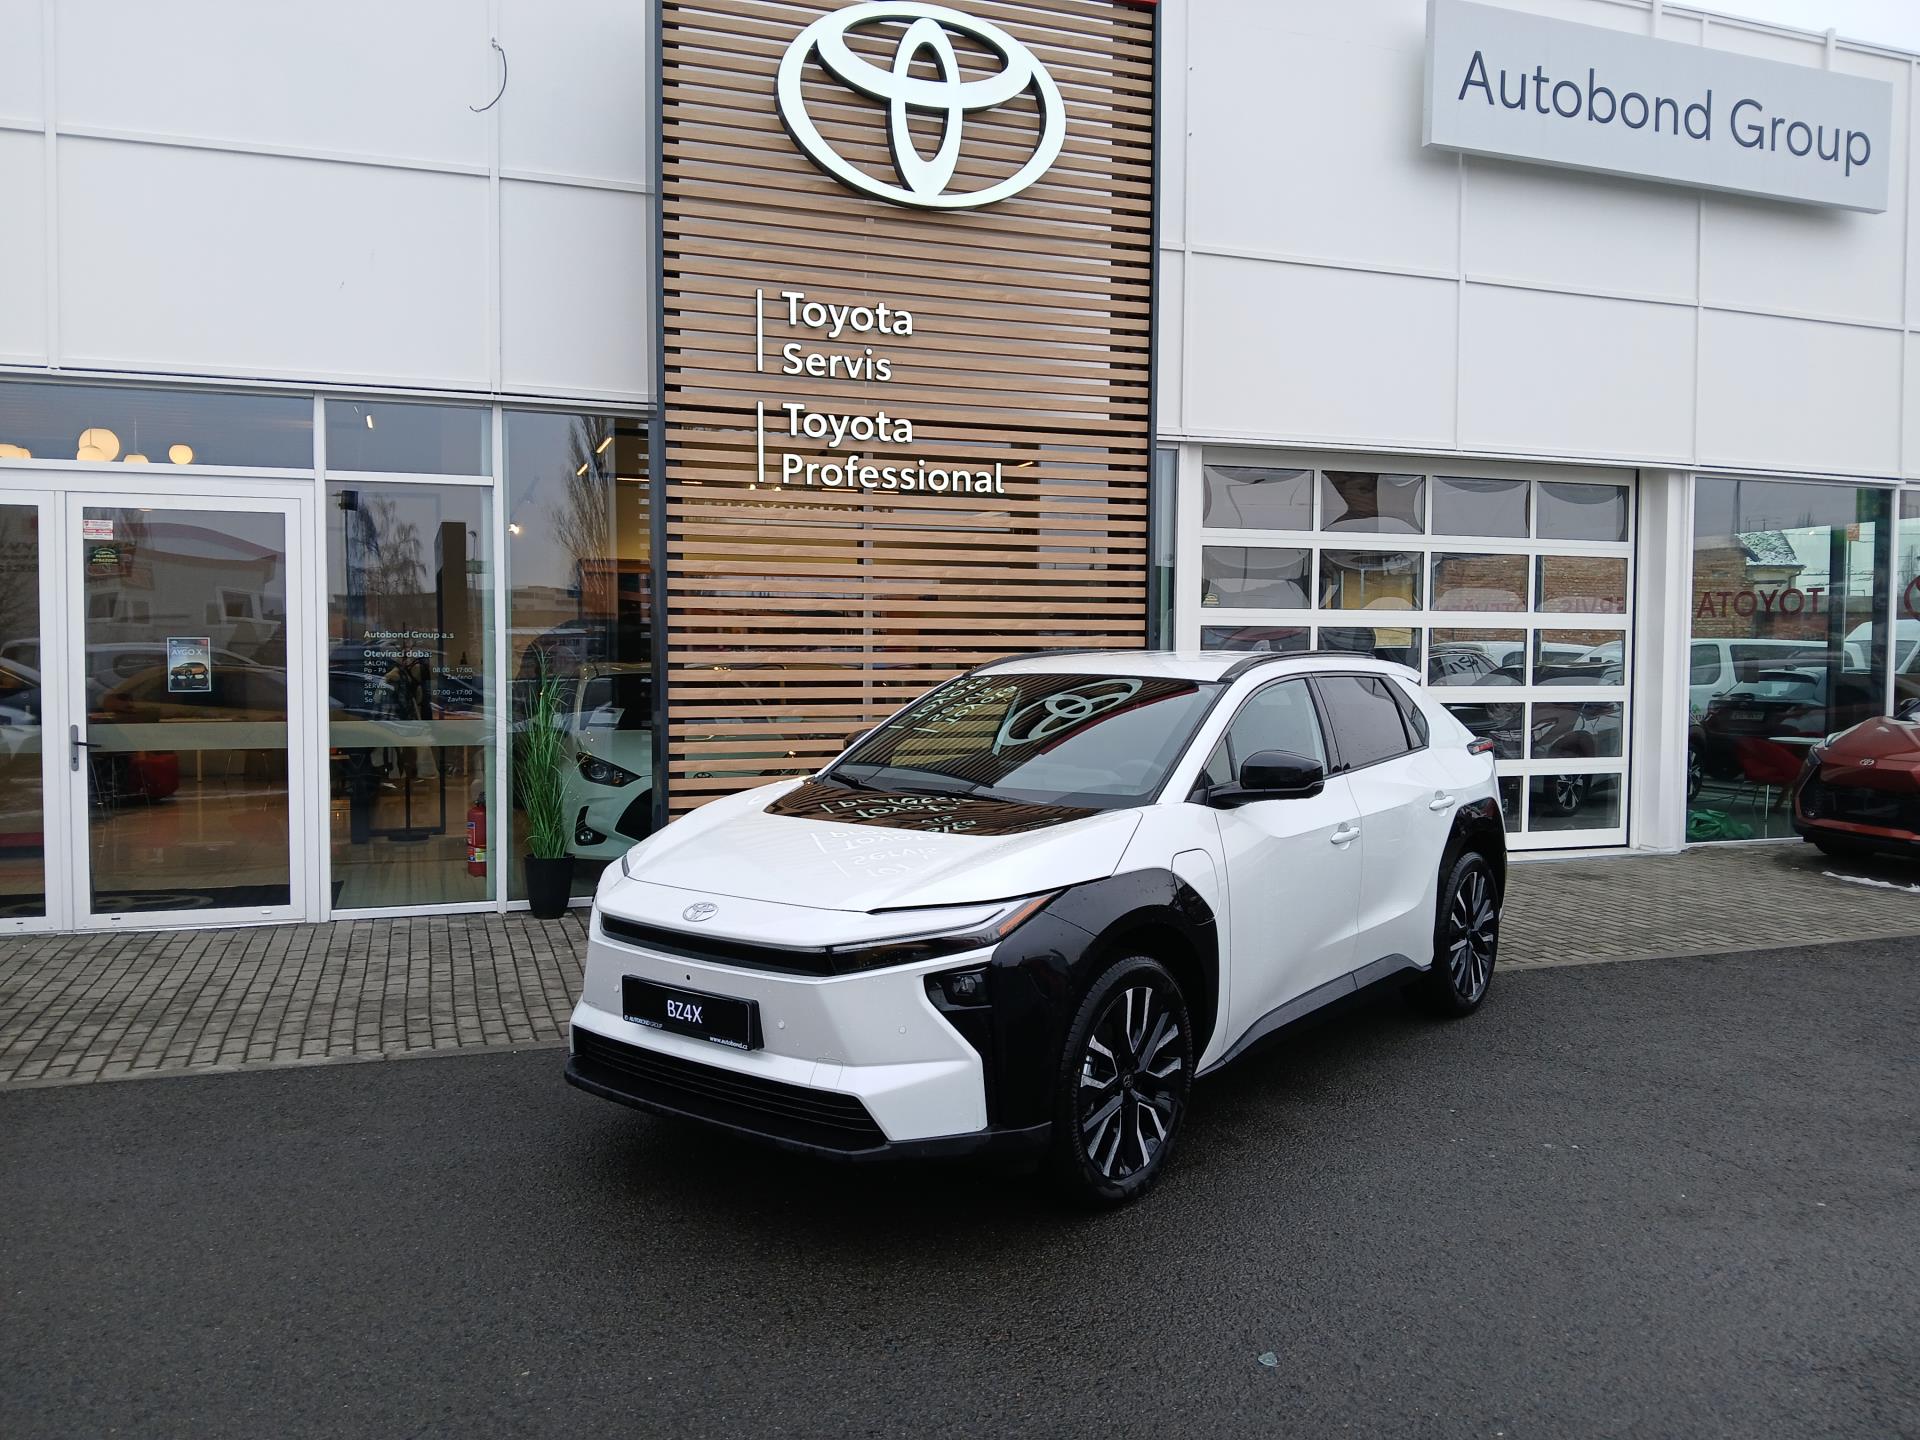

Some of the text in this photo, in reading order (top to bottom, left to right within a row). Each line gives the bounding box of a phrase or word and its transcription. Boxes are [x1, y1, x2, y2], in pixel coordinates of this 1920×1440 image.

[1458, 51, 1872, 177] Autobond Group
[781, 291, 914, 339] Toyota
[782, 343, 892, 382] Servis
[781, 403, 914, 448] Toyota
[782, 453, 1005, 494] Professional
[364, 631, 410, 639] Autobond
[411, 631, 440, 640] Group
[667, 999, 703, 1024] BZ4X
